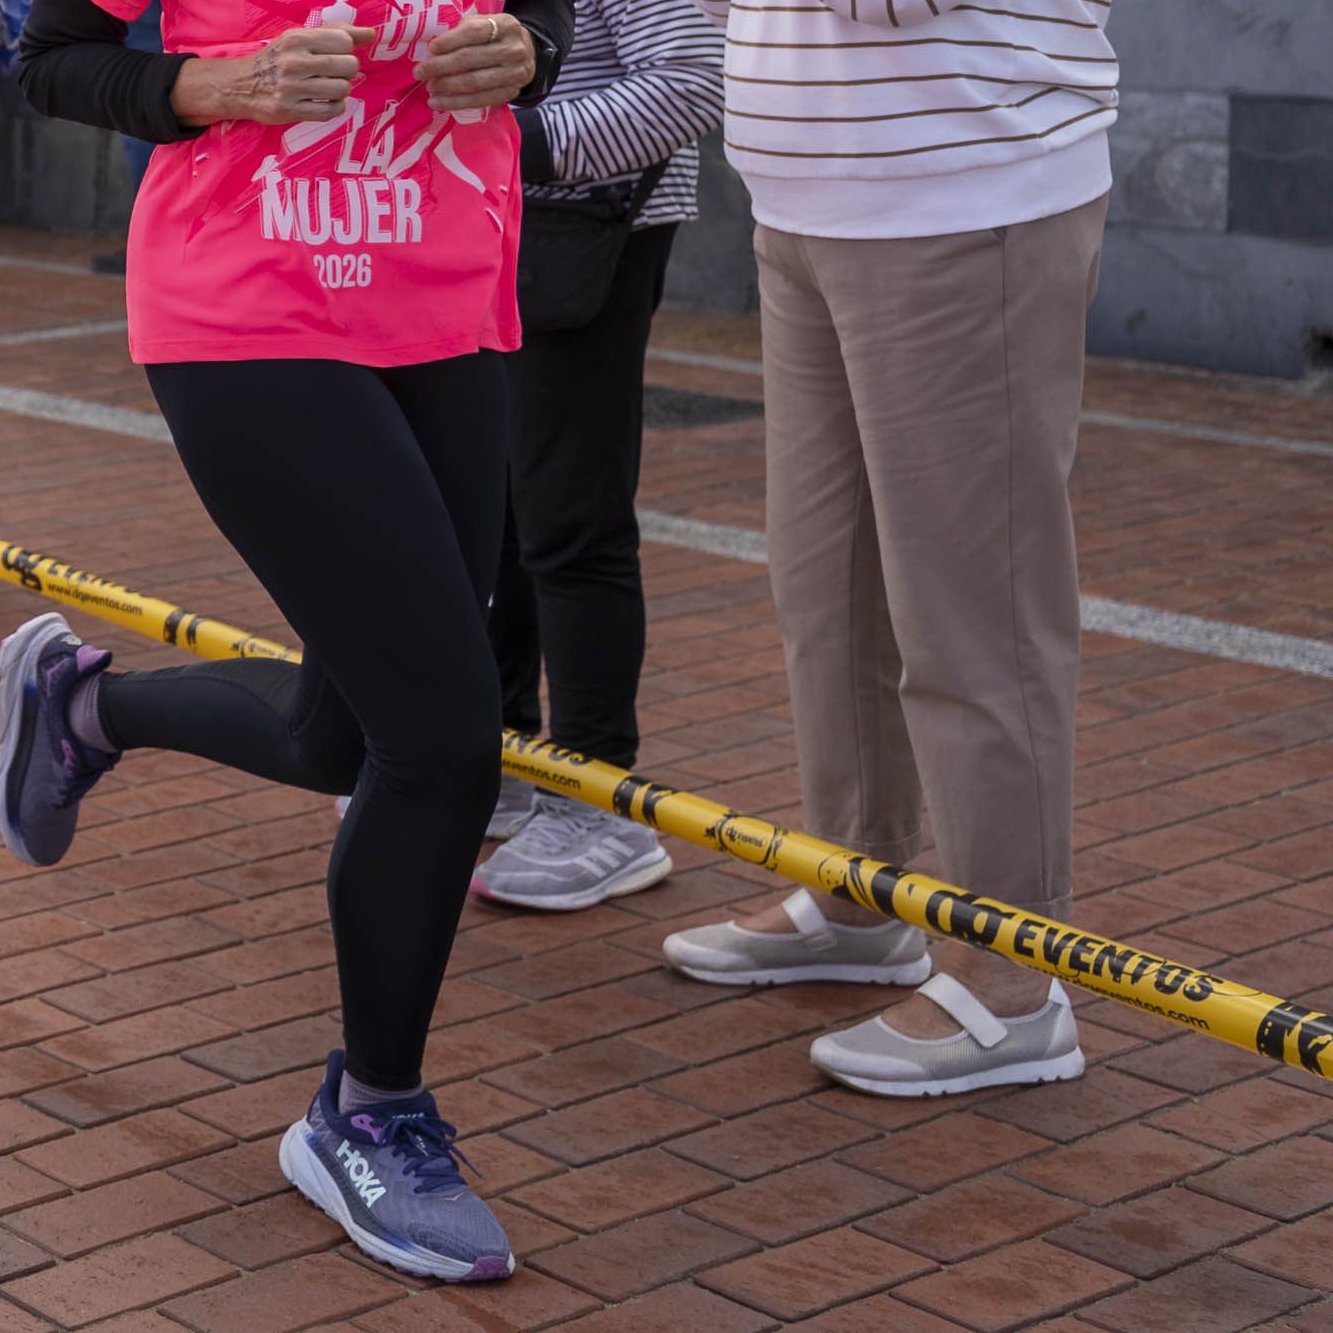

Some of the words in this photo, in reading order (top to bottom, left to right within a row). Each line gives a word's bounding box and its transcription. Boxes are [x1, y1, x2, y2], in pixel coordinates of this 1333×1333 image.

[335, 97, 397, 174] LA
[259, 169, 423, 245] MUJER
[312, 253, 373, 289] 2026
[1014, 918, 1223, 1003] EVENTOS
[336, 1139, 387, 1209] HOKA
